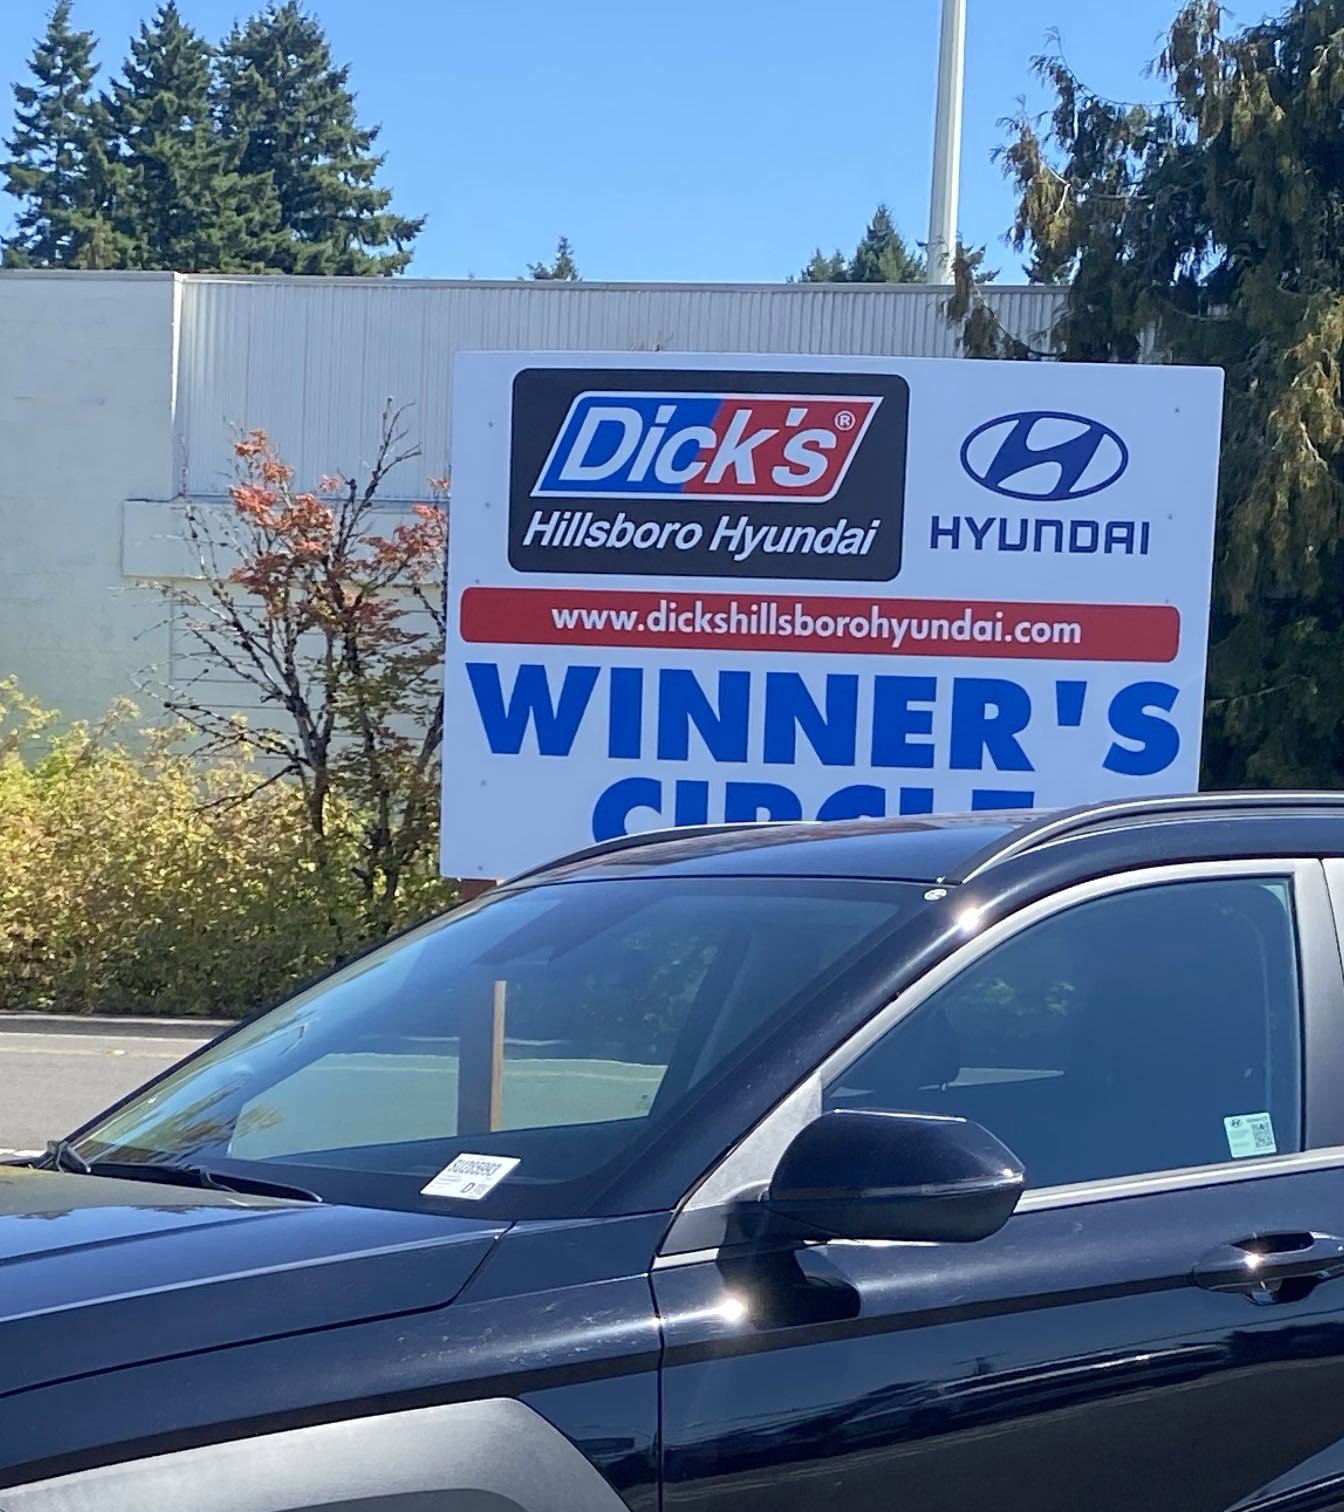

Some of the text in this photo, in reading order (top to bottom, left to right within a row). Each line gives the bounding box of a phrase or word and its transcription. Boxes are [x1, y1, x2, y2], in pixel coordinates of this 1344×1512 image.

[558, 405, 837, 487] Dick's
[522, 510, 882, 561] Hillsboro Hyundai
[929, 515, 1150, 556] HYUNDAI
[551, 600, 1082, 647] www.dickshillsborohyundai.com
[465, 662, 1181, 776] WINNER'S
